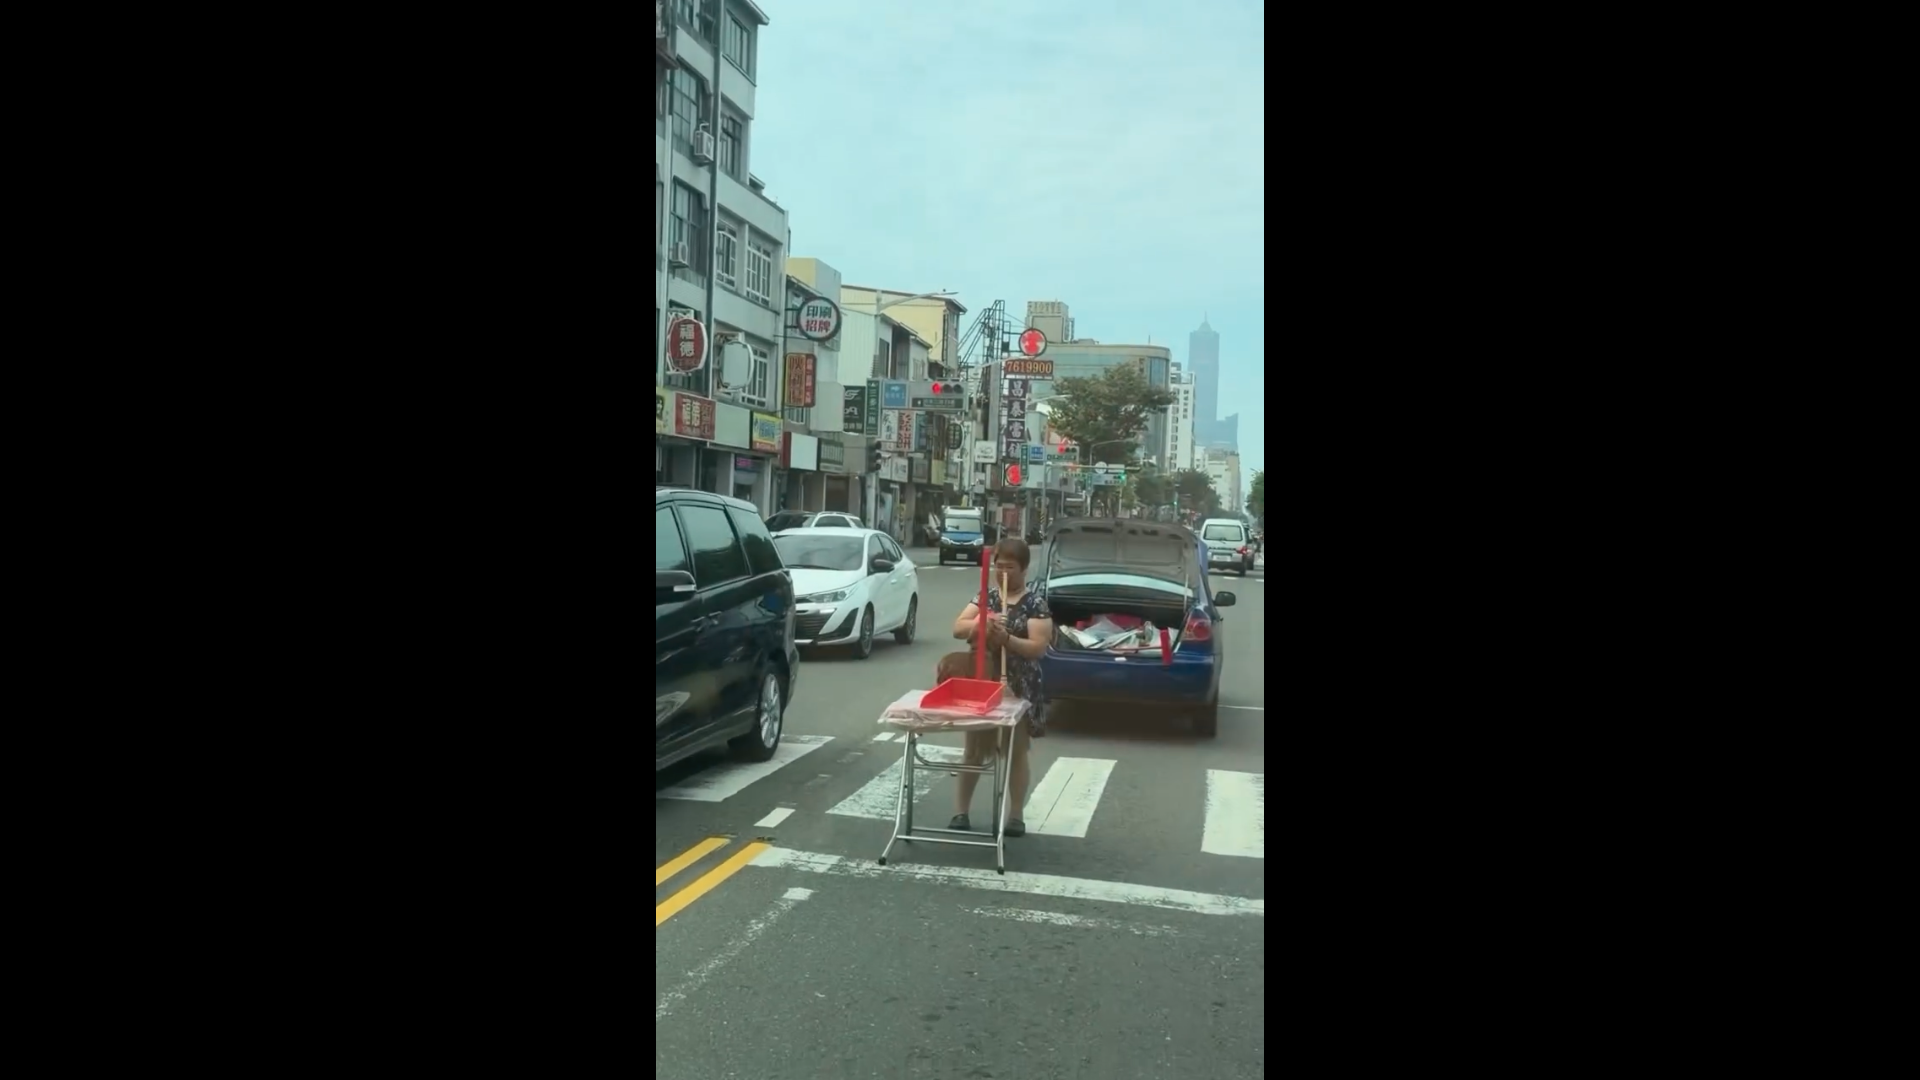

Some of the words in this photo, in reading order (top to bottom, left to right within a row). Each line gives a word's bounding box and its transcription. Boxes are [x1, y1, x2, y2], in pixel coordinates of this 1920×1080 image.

[807, 305, 832, 318] 印刷
[806, 319, 831, 332] 招牌
[680, 323, 695, 357] 福德
[1006, 361, 1052, 373] 7619900
